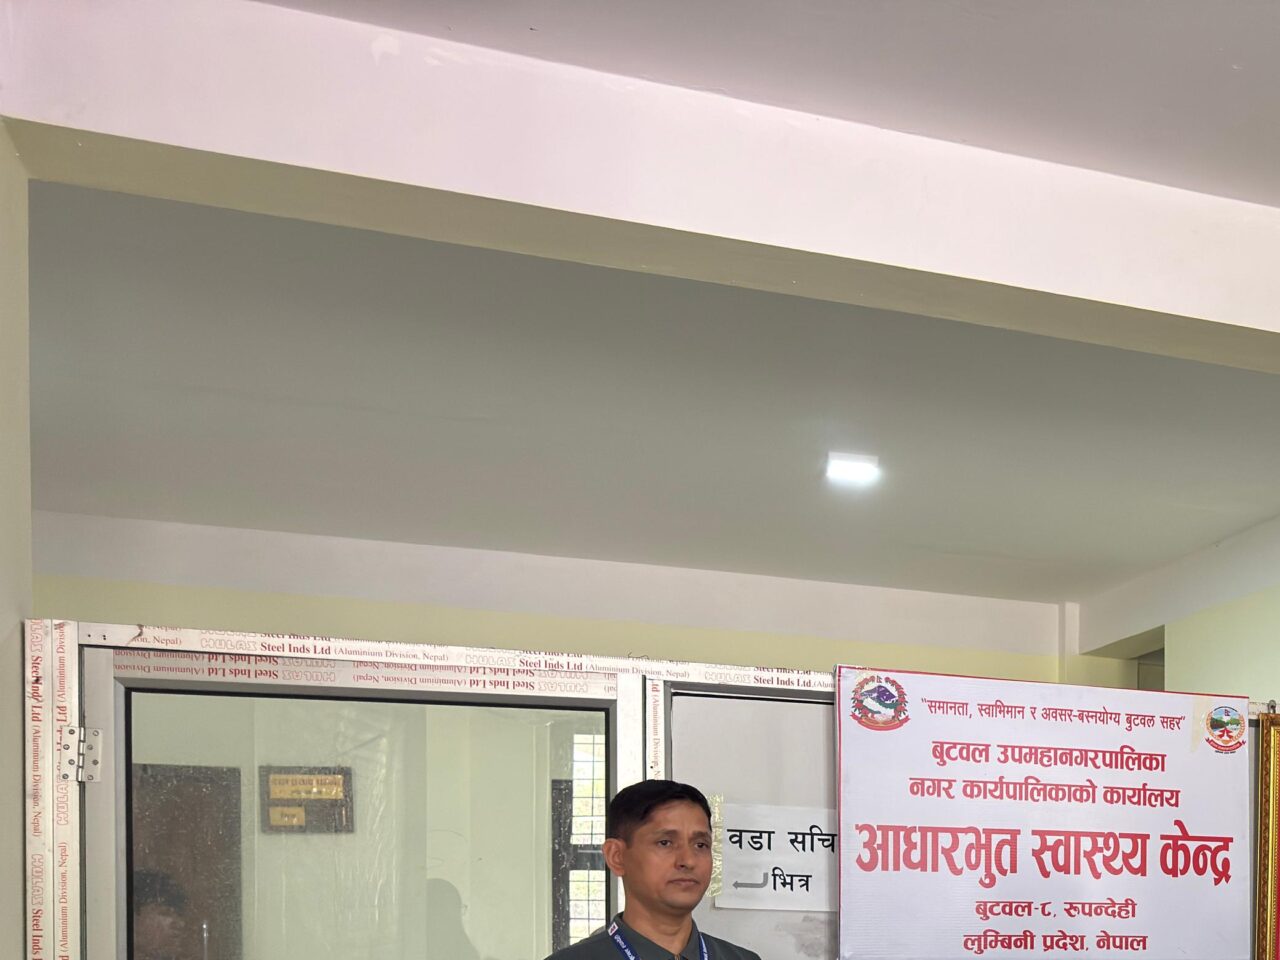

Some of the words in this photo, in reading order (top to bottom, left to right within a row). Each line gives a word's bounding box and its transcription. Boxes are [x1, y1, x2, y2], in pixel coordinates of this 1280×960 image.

[229, 655, 251, 664] Inds
[254, 656, 278, 666] Steel
[260, 642, 285, 653] Steel
[288, 643, 310, 654] Inds
[313, 645, 331, 655] Ltd
[519, 658, 541, 669] Steel
[544, 659, 564, 670] Inds
[566, 661, 583, 671] Ltd
[753, 675, 774, 685] Steel
[776, 677, 795, 687] Inds
[797, 679, 812, 688] Ltd
[208, 667, 226, 677] Ltd
[229, 668, 251, 678] Inds
[254, 669, 278, 679] Steel
[469, 679, 486, 688] Ltd
[489, 680, 510, 690] Inds
[512, 680, 535, 690] Steel
[31, 705, 43, 722] Ltd
[977, 700, 1025, 720] स्वाभिमान
[1029, 707, 1037, 720] र
[1125, 713, 1155, 732] बुटवल
[932, 741, 991, 766] बुटवल
[997, 743, 1167, 772] उपमहानगरपालिका
[909, 777, 956, 799] नगर
[962, 776, 1097, 804] कार्यपालिकाको
[1102, 782, 1181, 808] कार्यालय
[727, 829, 775, 851] वडा
[1031, 829, 1150, 880] स्वास्थ्य
[1160, 820, 1234, 886] केन्द्र
[772, 867, 812, 892] भित्र
[32, 909, 43, 932] Steel
[32, 935, 43, 955] Inds
[963, 929, 1036, 954] लुम्बिनी
[1096, 930, 1148, 951] नेपाल
